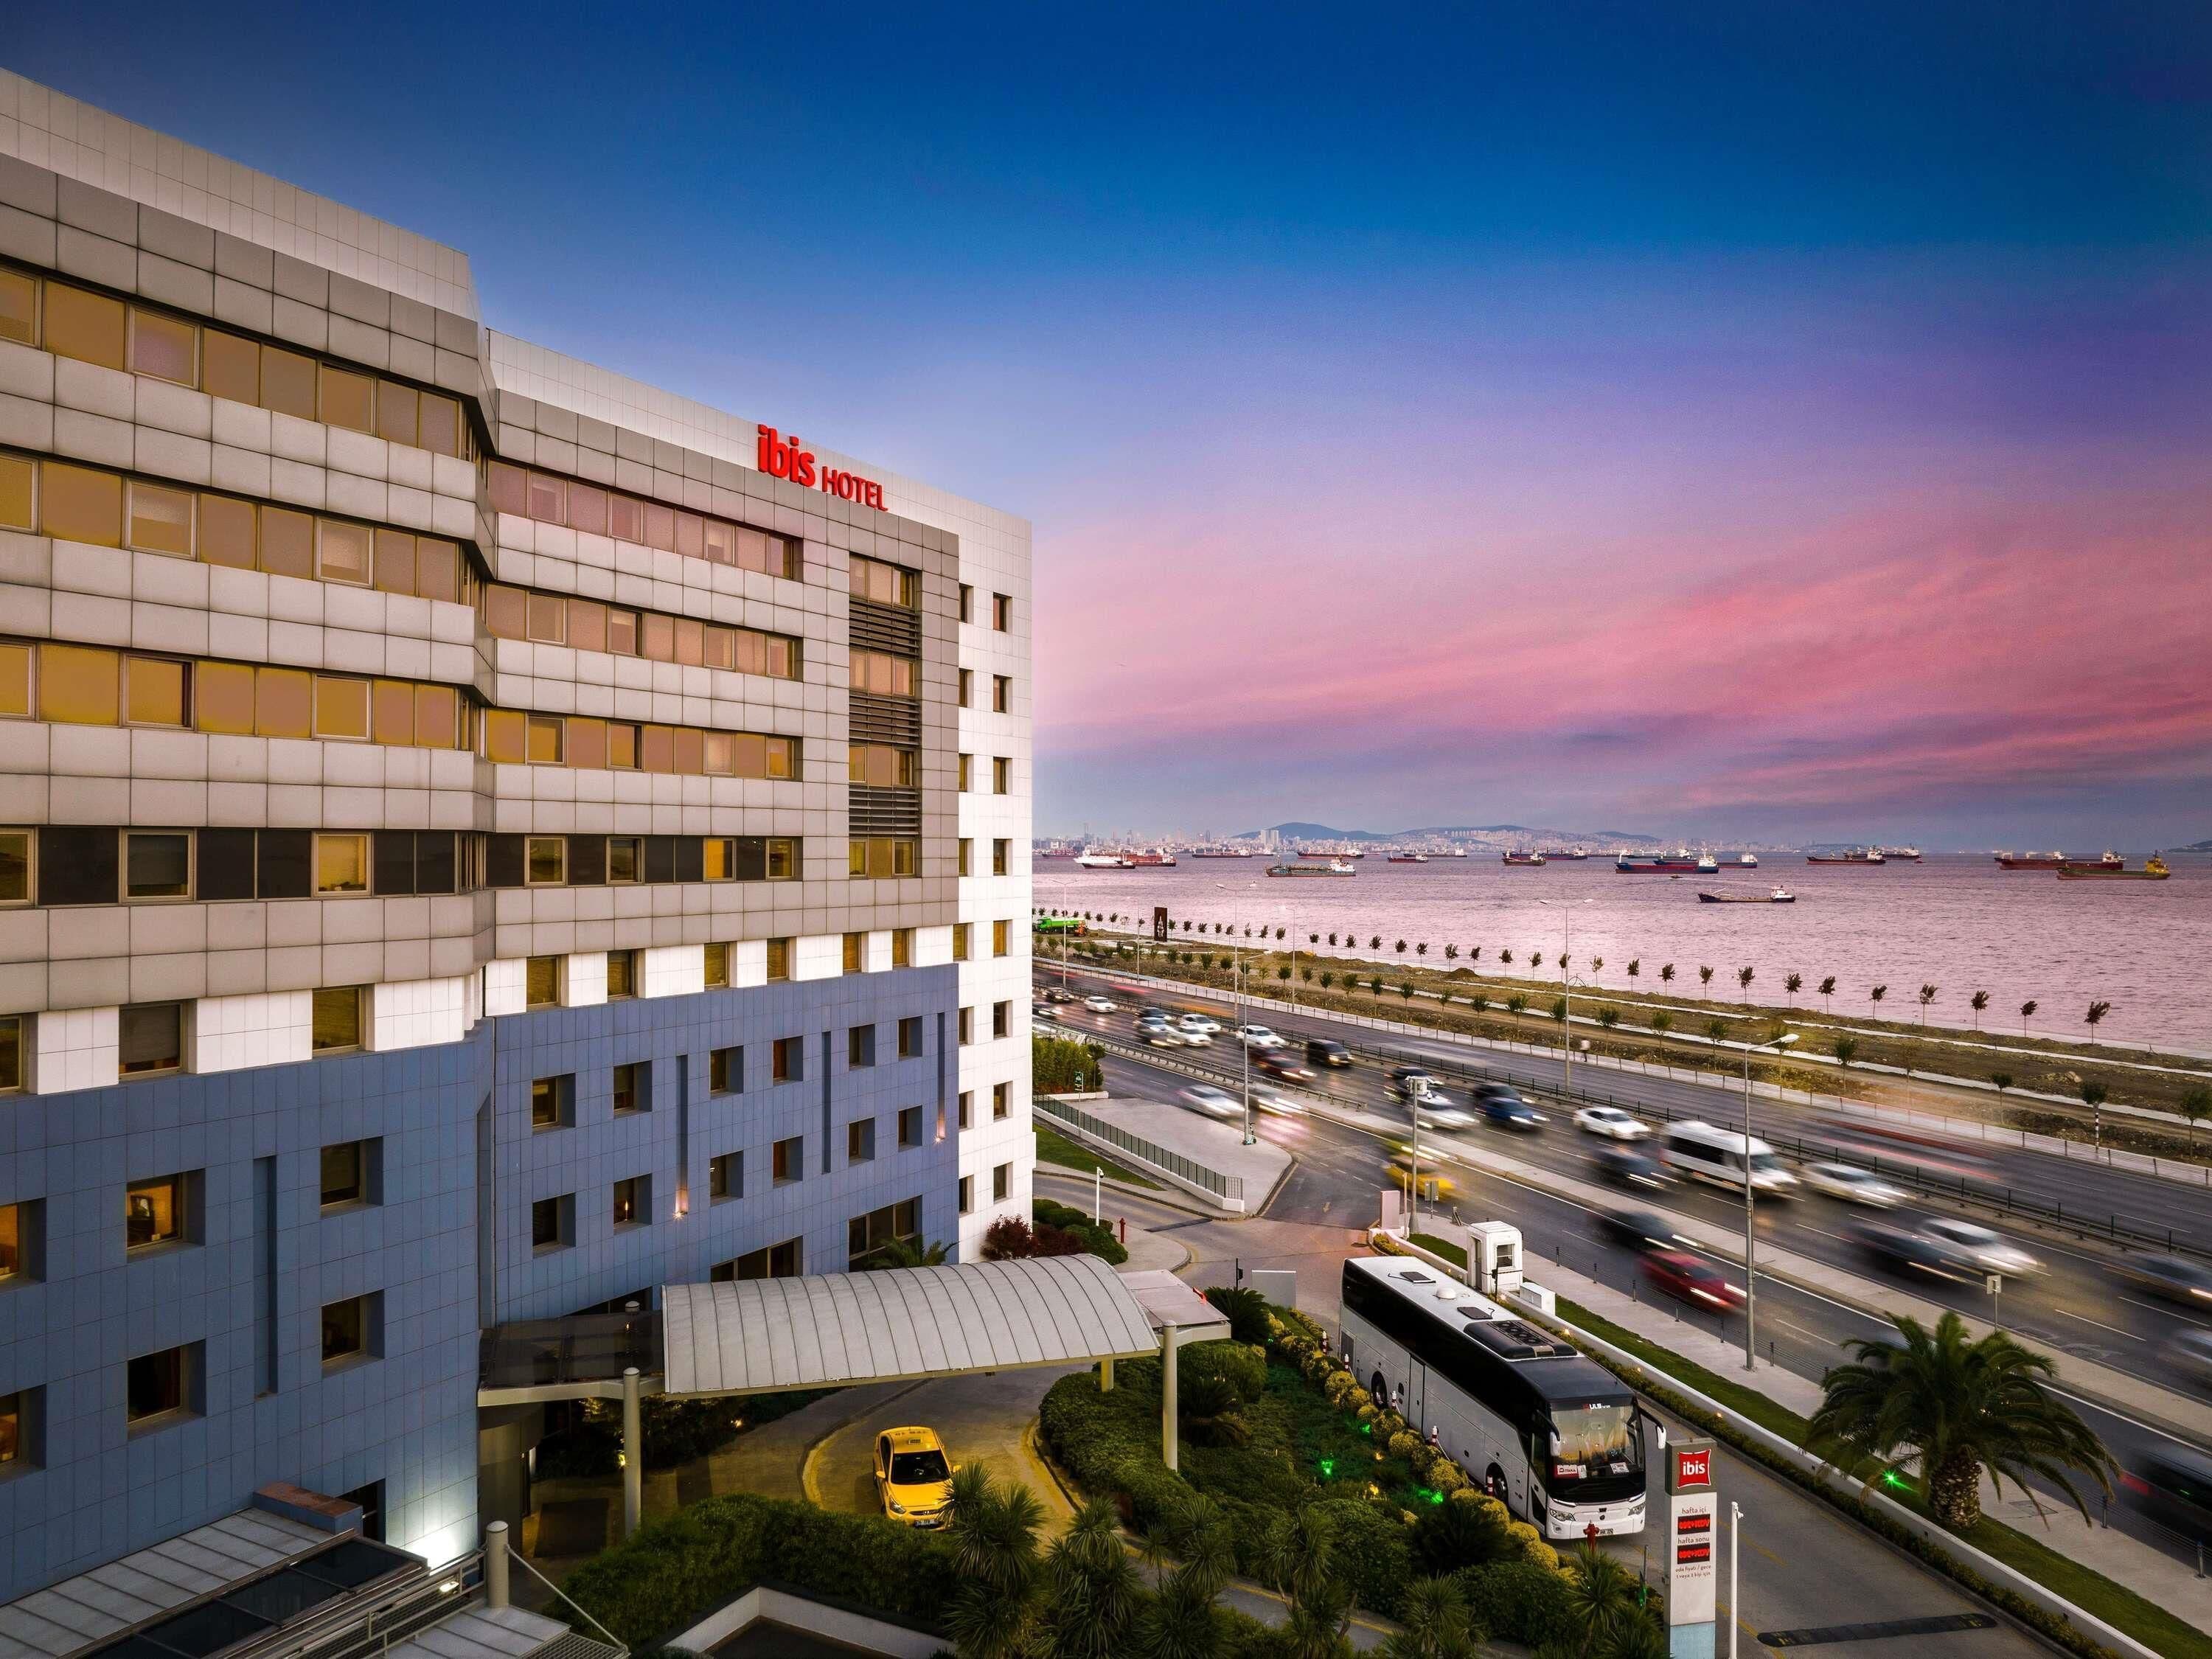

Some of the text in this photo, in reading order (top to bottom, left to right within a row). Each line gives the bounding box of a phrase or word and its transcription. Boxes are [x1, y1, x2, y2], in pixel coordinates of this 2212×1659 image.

[758, 424, 888, 512] ibis HOTEL
[1683, 1461, 1705, 1475] ibis
